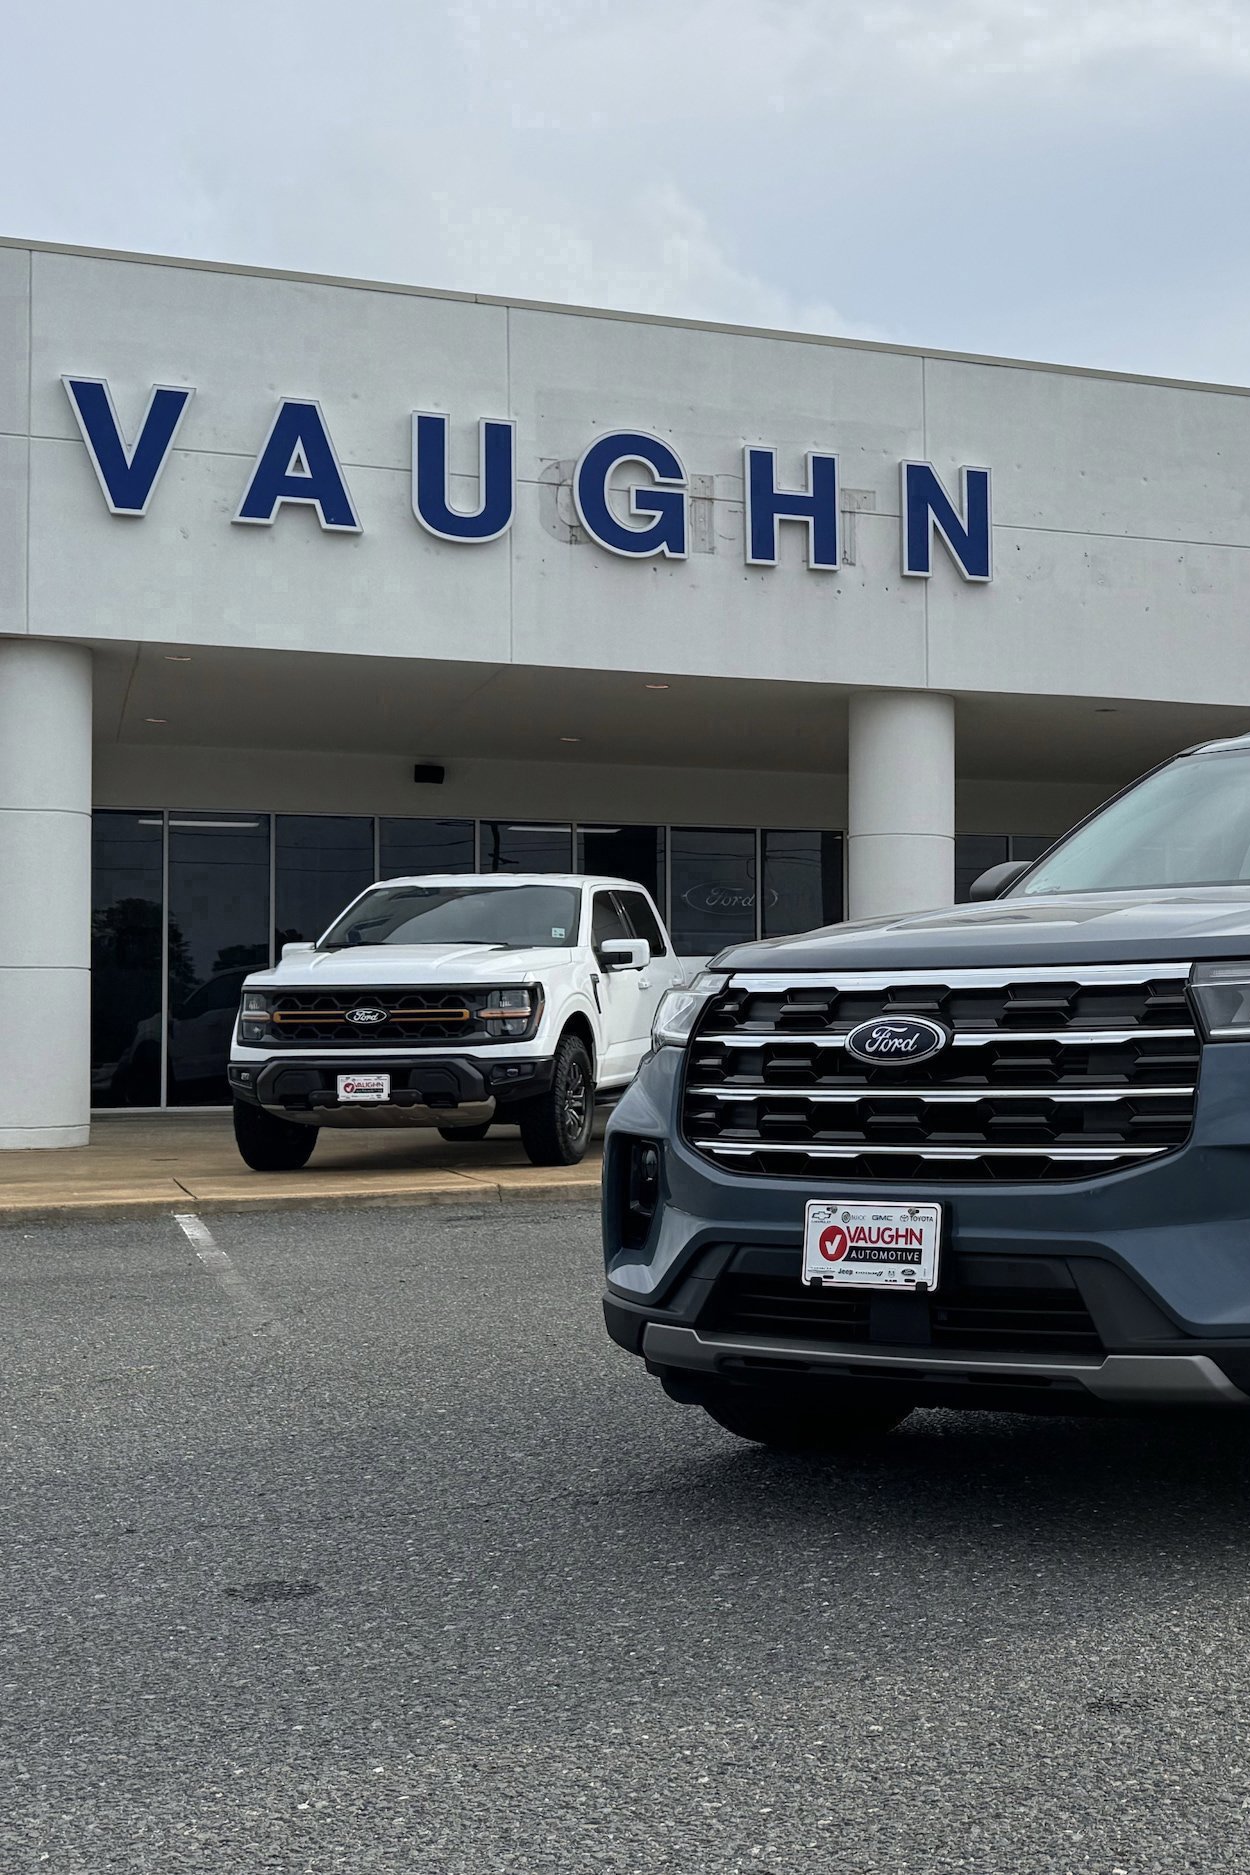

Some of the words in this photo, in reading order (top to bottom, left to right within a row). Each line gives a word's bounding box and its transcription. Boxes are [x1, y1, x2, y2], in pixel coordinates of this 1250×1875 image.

[60, 374, 993, 583] VAUGHN
[706, 886, 756, 907] Ford
[353, 1010, 380, 1021] Ford
[865, 1025, 921, 1053] Ford
[871, 1214, 894, 1222] GMC
[846, 1226, 923, 1245] VAUGHN
[850, 1249, 920, 1262] AUTOMOTIVE
[838, 1268, 853, 1276] Jeep
